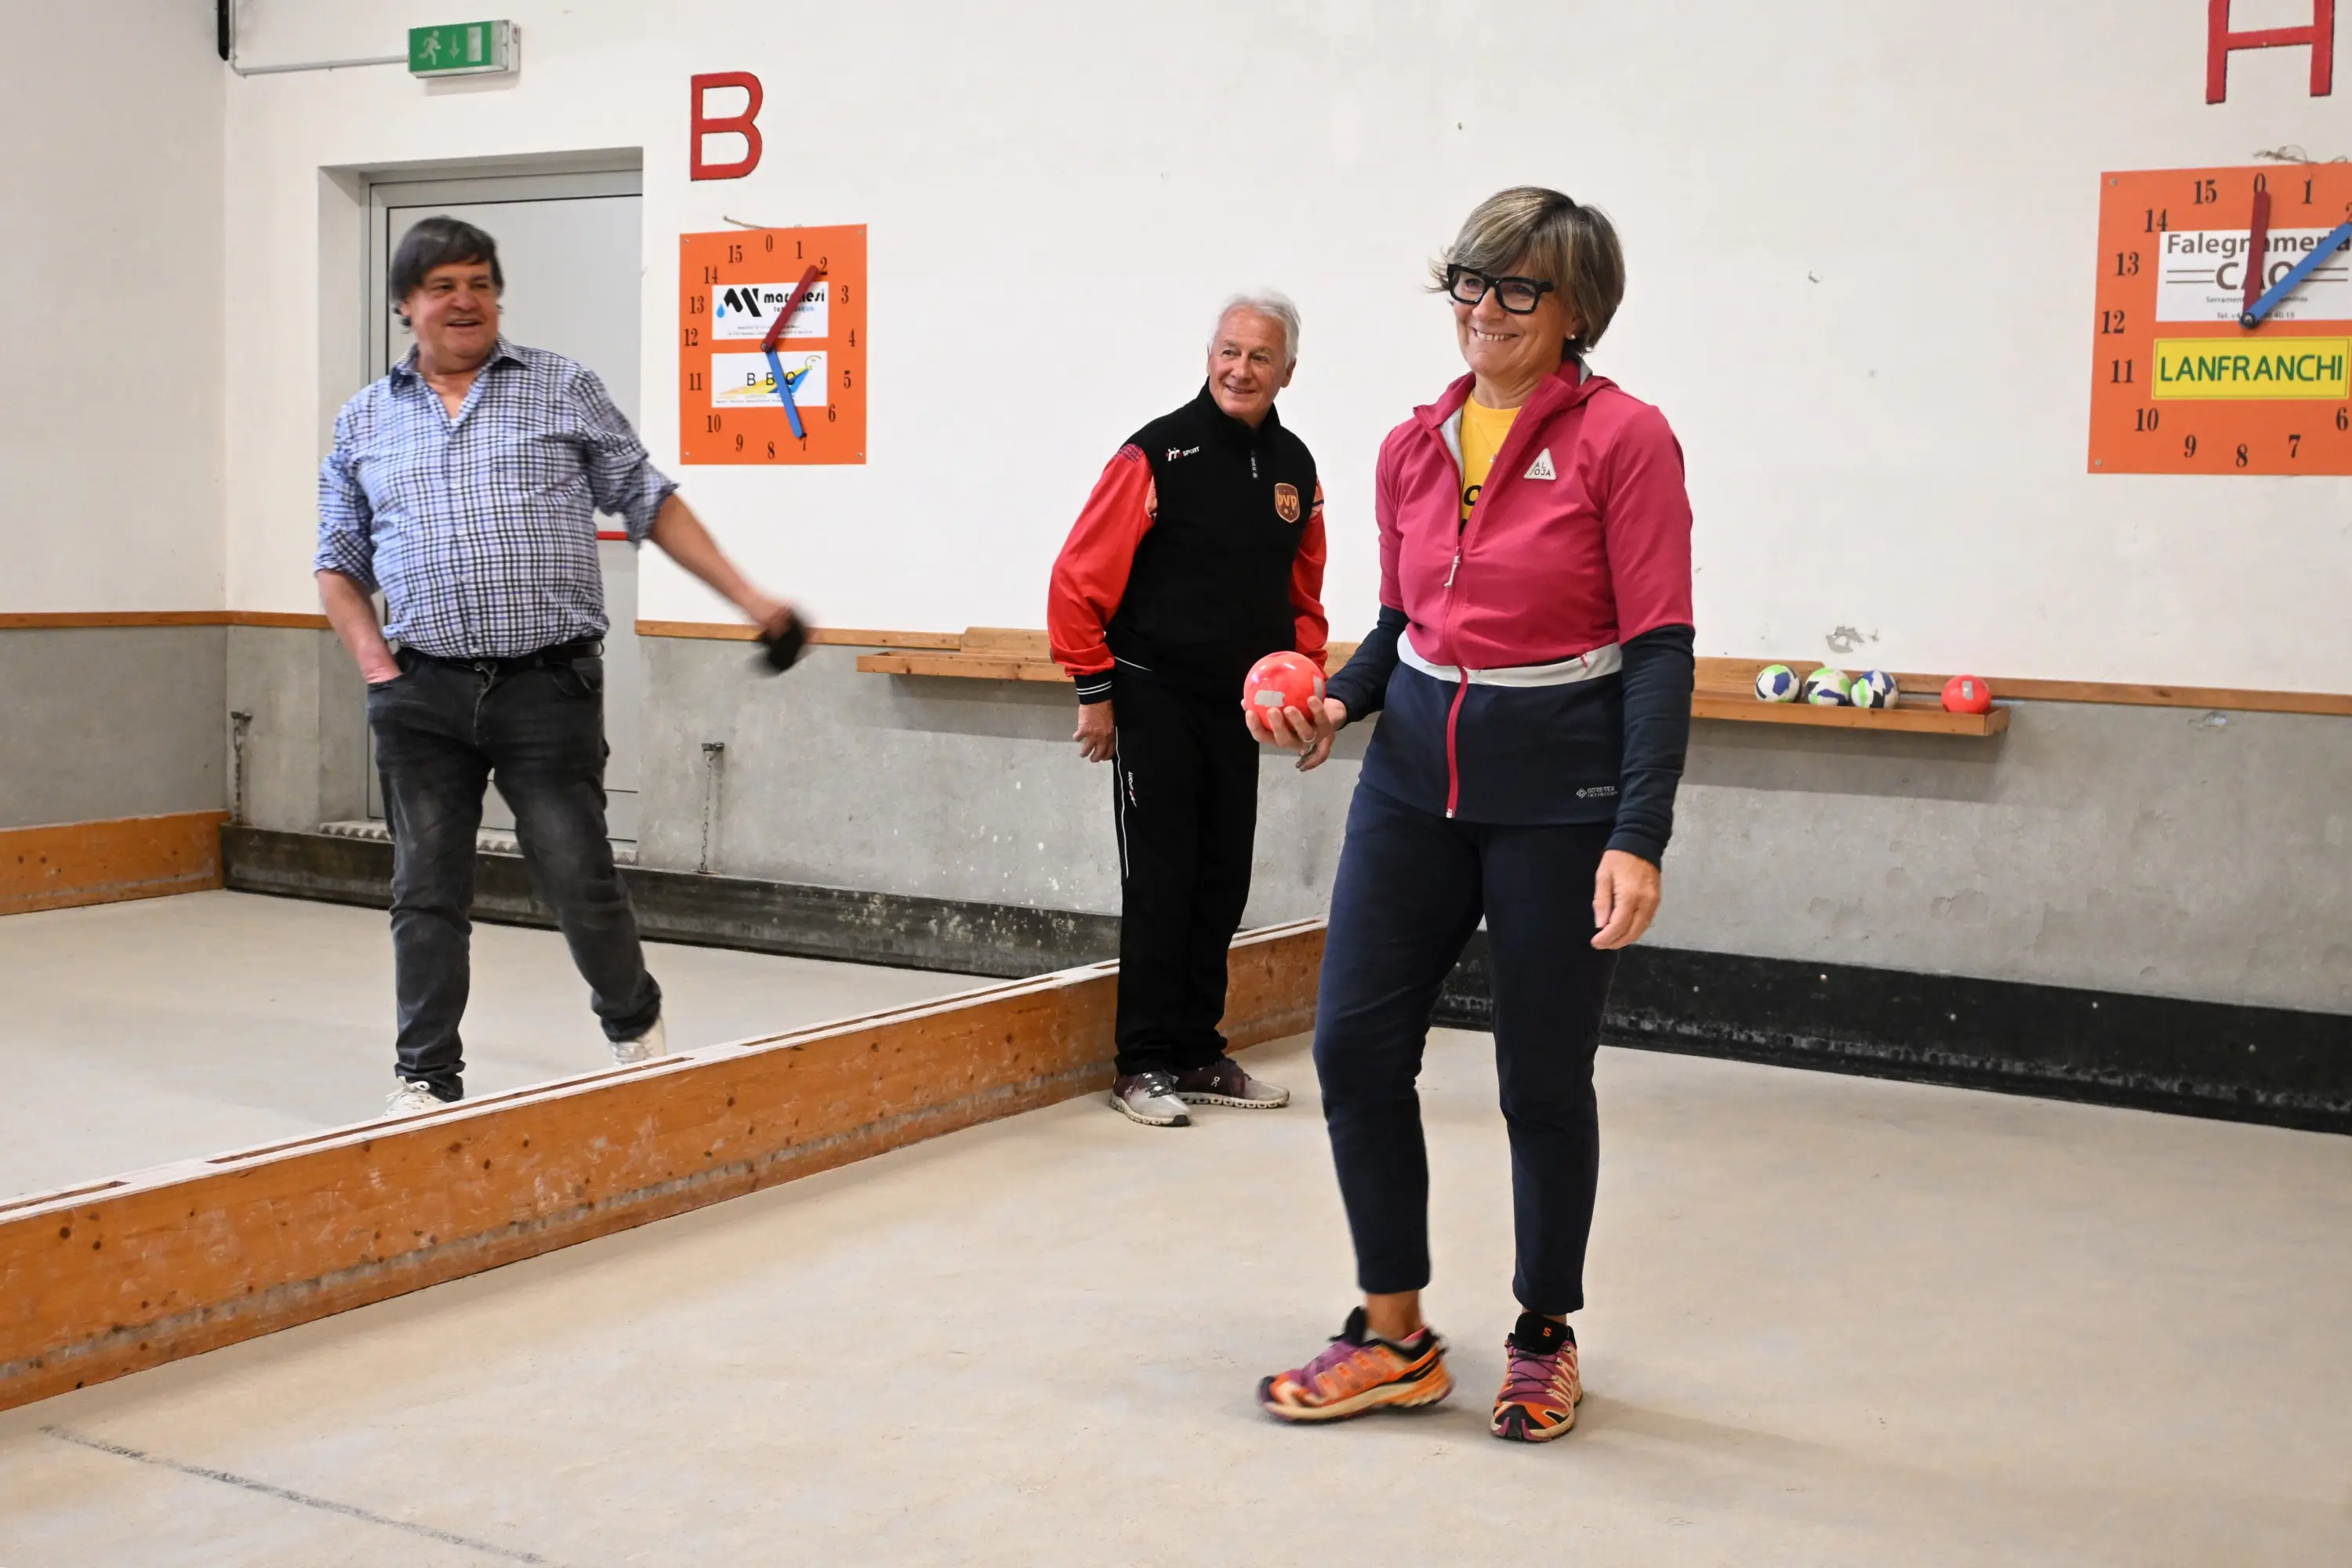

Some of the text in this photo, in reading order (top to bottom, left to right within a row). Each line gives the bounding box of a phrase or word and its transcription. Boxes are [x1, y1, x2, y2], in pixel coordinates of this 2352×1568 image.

[690, 71, 764, 182] B
[2253, 172, 2267, 192] 0
[2302, 179, 2313, 205] 1
[2194, 180, 2218, 205] 15
[2145, 209, 2169, 233] 14
[765, 234, 774, 252] 0
[797, 241, 803, 260] 1
[728, 245, 743, 264] 15
[2116, 251, 2140, 277] 13
[703, 266, 719, 285] 14
[820, 256, 829, 276] 2
[690, 295, 705, 314] 13
[841, 285, 850, 304] 3
[2101, 310, 2125, 335] 12
[684, 327, 699, 347] 12
[848, 328, 856, 347] 4
[2111, 359, 2133, 383] 11
[2160, 355, 2343, 382] LANFRANCHI
[689, 372, 702, 391] 11
[843, 370, 851, 389] 5
[828, 403, 837, 423] 6
[2135, 408, 2160, 432] 10
[2336, 406, 2350, 431] 6
[706, 414, 722, 434] 10
[735, 434, 744, 452] 9
[767, 441, 775, 459] 8
[1182, 446, 1200, 456] SPORT
[2183, 434, 2198, 458] 9
[2288, 433, 2302, 459] 7
[2235, 443, 2249, 468] 8
